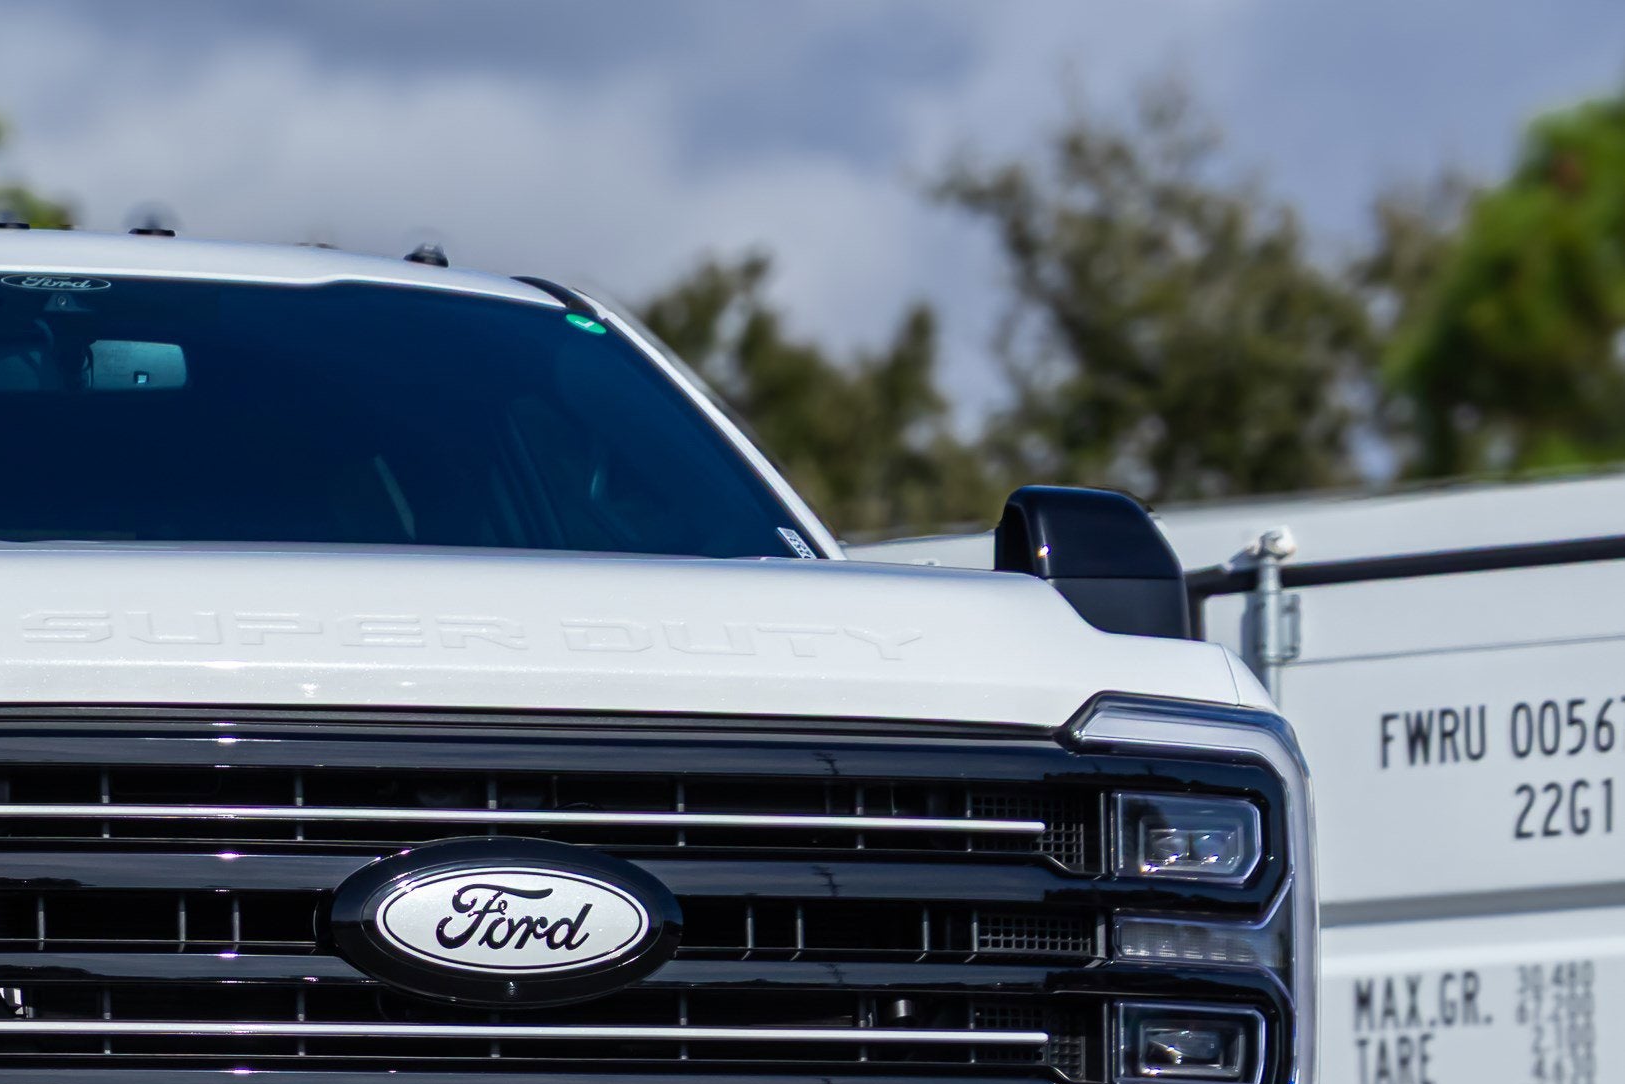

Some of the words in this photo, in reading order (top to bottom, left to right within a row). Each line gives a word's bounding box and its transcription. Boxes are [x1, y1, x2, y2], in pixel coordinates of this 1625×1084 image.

[21, 273, 93, 289] Ford
[21, 609, 529, 651] SUPER
[560, 616, 924, 661] DUTY
[1380, 703, 1487, 770] FWRU
[1509, 694, 1625, 759] 0056
[1513, 776, 1614, 840] 22G1
[435, 882, 593, 951] Ford
